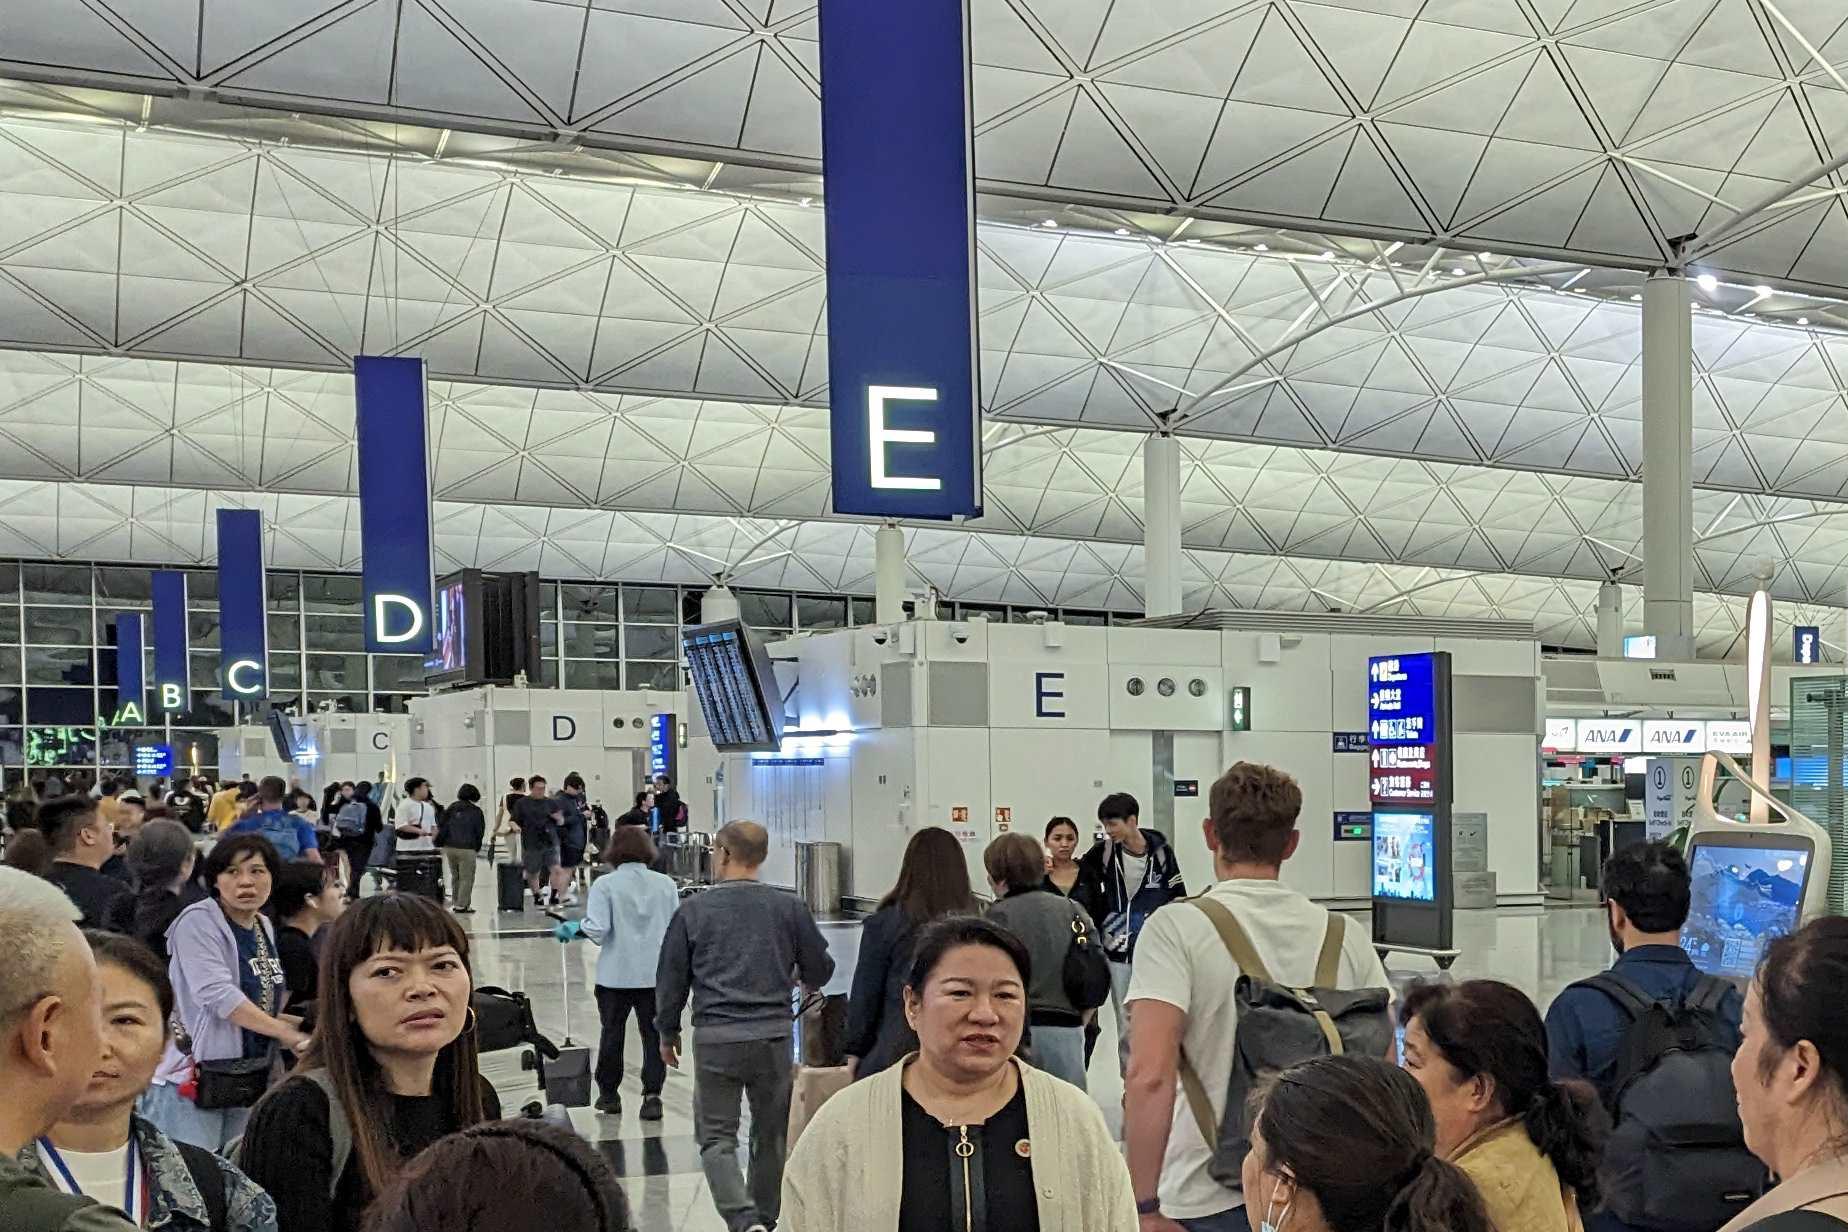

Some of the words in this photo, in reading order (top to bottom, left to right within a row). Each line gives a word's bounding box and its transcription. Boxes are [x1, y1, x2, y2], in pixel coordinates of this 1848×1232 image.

[868, 385, 941, 490] E
[374, 594, 423, 643] D
[228, 660, 261, 693] C
[162, 683, 181, 708] B
[1036, 672, 1065, 718] E
[120, 701, 142, 723] A
[552, 715, 576, 741] D
[1584, 729, 1617, 743] ANA
[1650, 729, 1682, 744] ANA
[372, 732, 389, 750] C
